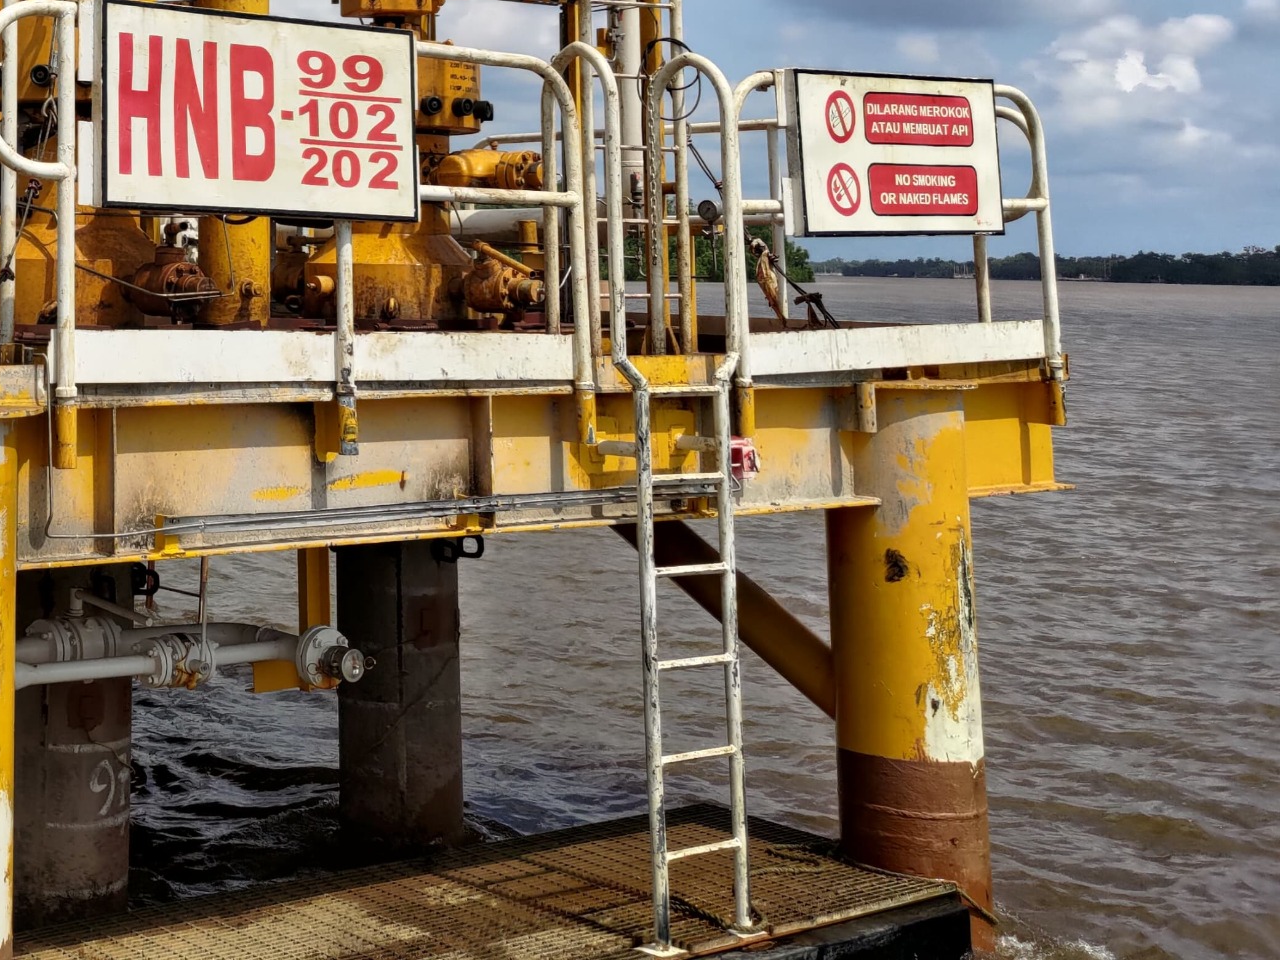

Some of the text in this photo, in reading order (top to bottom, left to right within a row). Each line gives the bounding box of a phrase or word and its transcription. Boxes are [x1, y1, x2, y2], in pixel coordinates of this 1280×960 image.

[296, 50, 384, 93] 99
[119, 32, 275, 181] HNB
[867, 103, 970, 119] DILARANG MEROKOK
[871, 122, 969, 136] ATAU MEMBUAT API
[301, 147, 399, 190] 202
[895, 174, 956, 187] NO SMOKING
[880, 192, 969, 205] OR NAKED FLAMES
